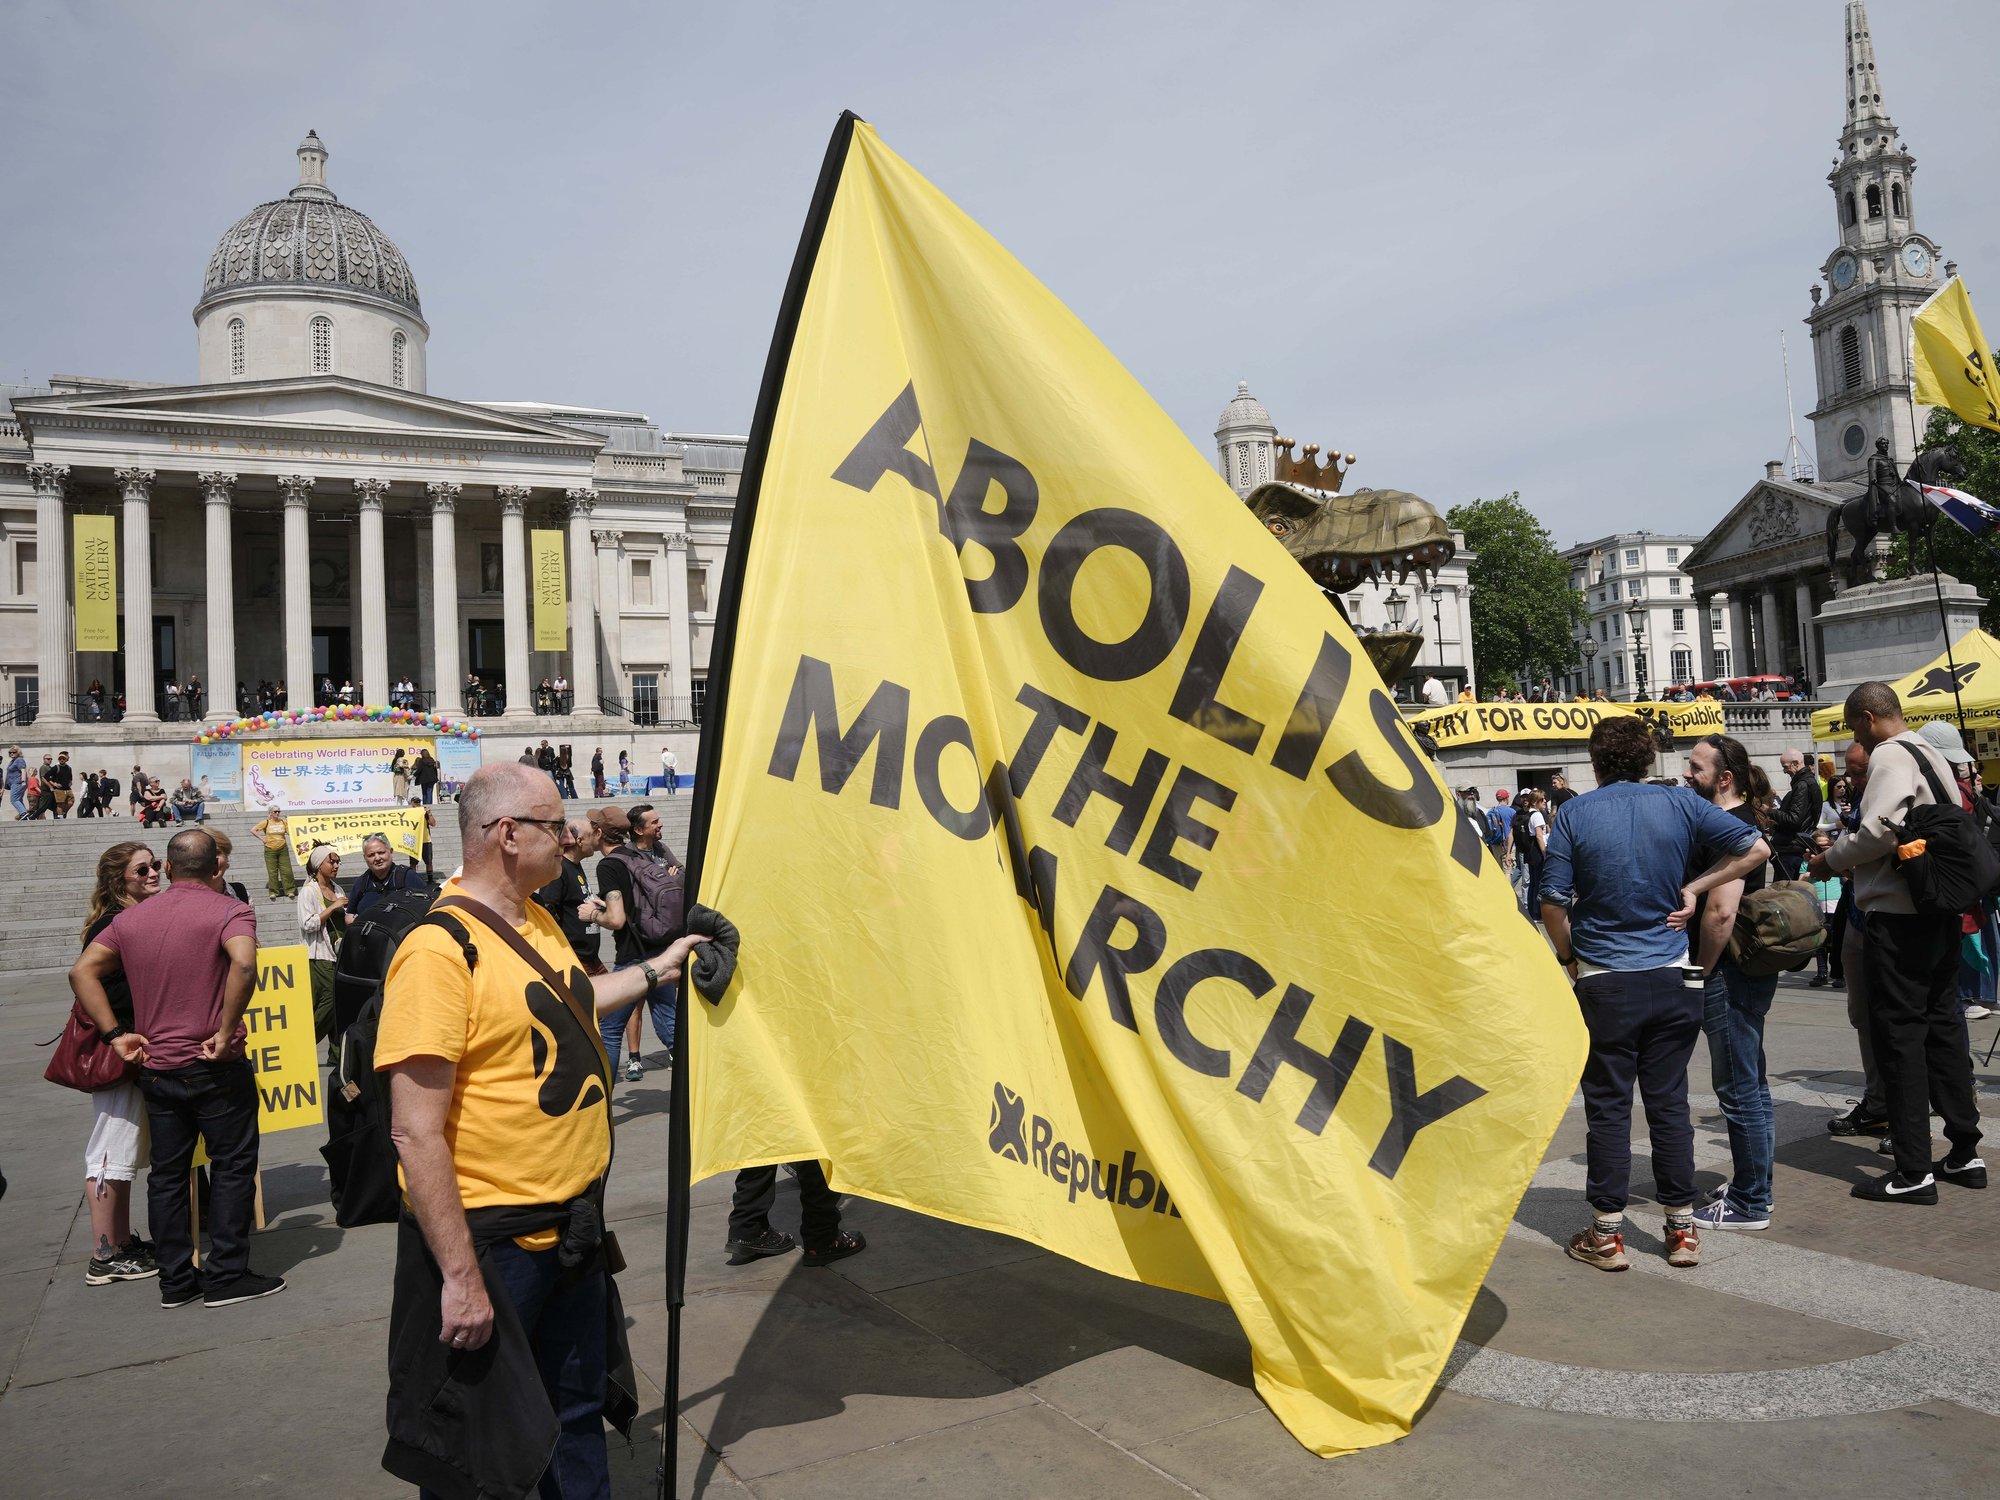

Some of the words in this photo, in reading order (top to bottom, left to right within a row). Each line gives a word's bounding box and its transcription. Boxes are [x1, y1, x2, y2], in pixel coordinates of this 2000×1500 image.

[169, 438, 219, 452] THE
[238, 443, 364, 460] NATIONAL
[381, 450, 485, 466] GALLERY
[85, 537, 96, 600] NATIONAL
[97, 537, 110, 601] GALLERY
[541, 549, 550, 605] NATIONAL
[550, 550, 561, 606] GALLERY
[1429, 709, 1469, 738] TRY
[1475, 707, 1527, 731] FOR
[251, 751, 313, 760] Celebrating
[316, 749, 347, 758] World
[350, 748, 380, 757] Falun
[408, 746, 422, 755] Da
[324, 780, 363, 793] 5.13
[1008, 683, 1238, 892] THE
[307, 811, 406, 823] Democracy
[311, 799, 353, 807] Compassion
[295, 823, 327, 837] Not
[334, 818, 419, 831] Monarchy
